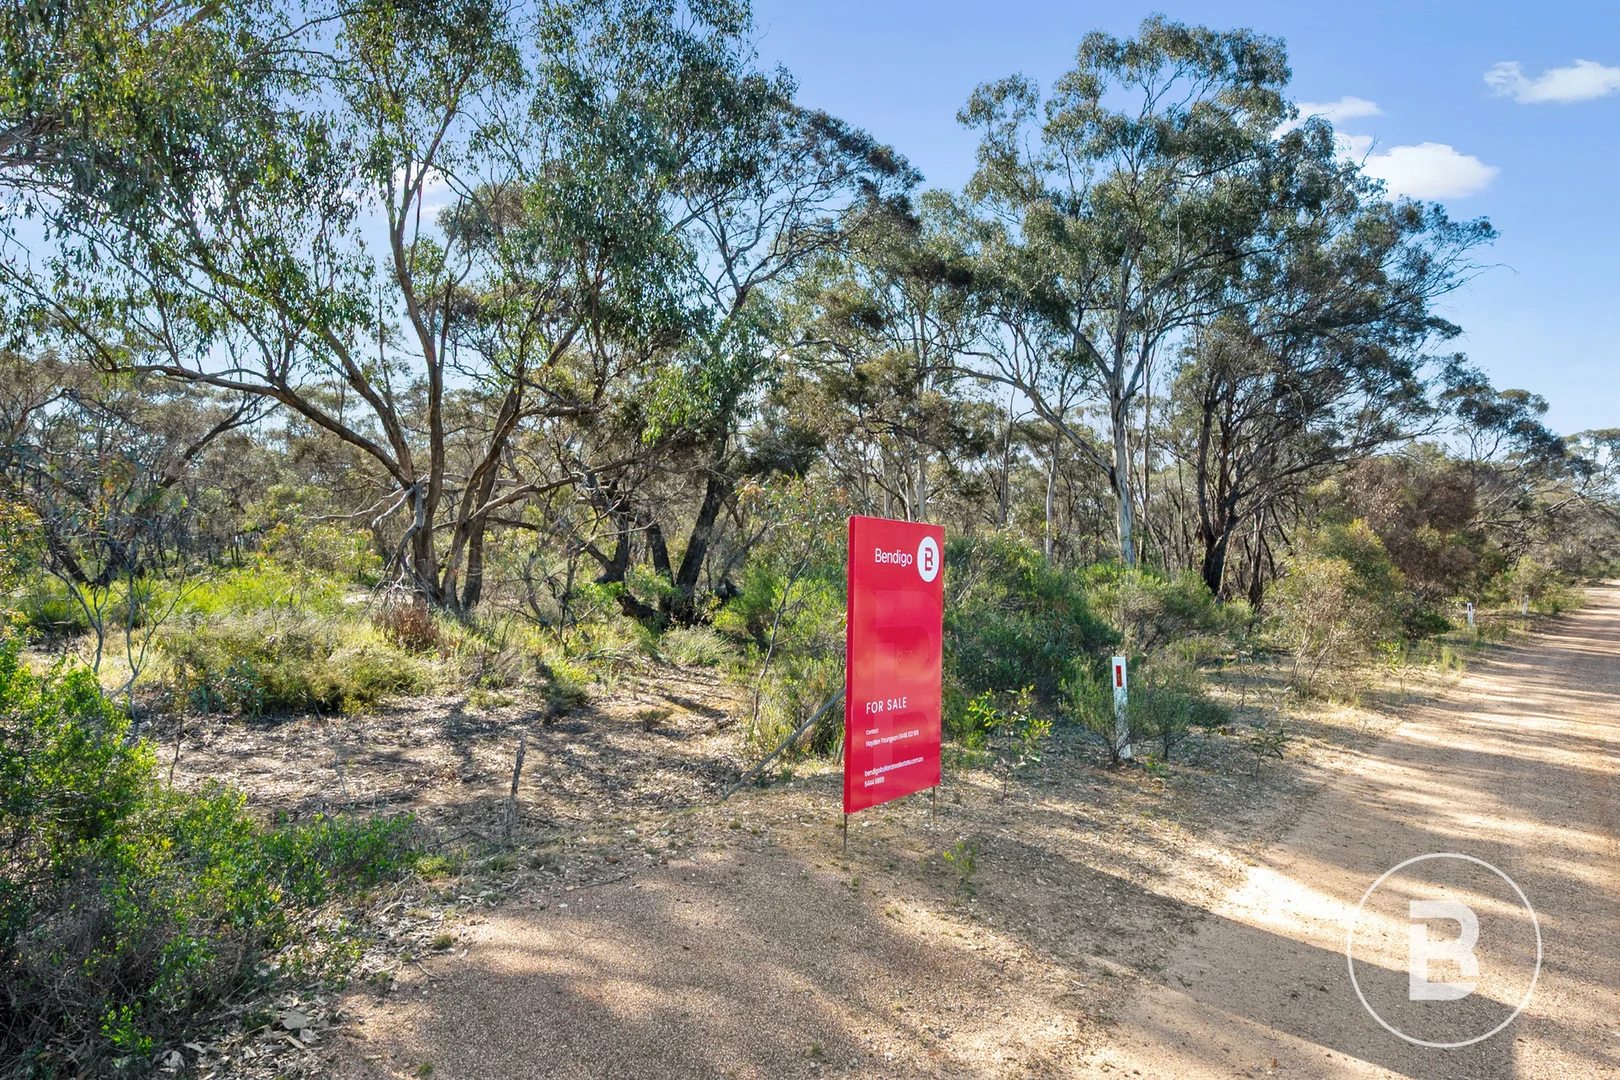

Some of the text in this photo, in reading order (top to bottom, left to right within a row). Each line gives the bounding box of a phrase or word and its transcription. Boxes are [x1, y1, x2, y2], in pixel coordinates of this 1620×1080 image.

[875, 548, 912, 567] Bendigo
[866, 696, 907, 714] FOR SALE
